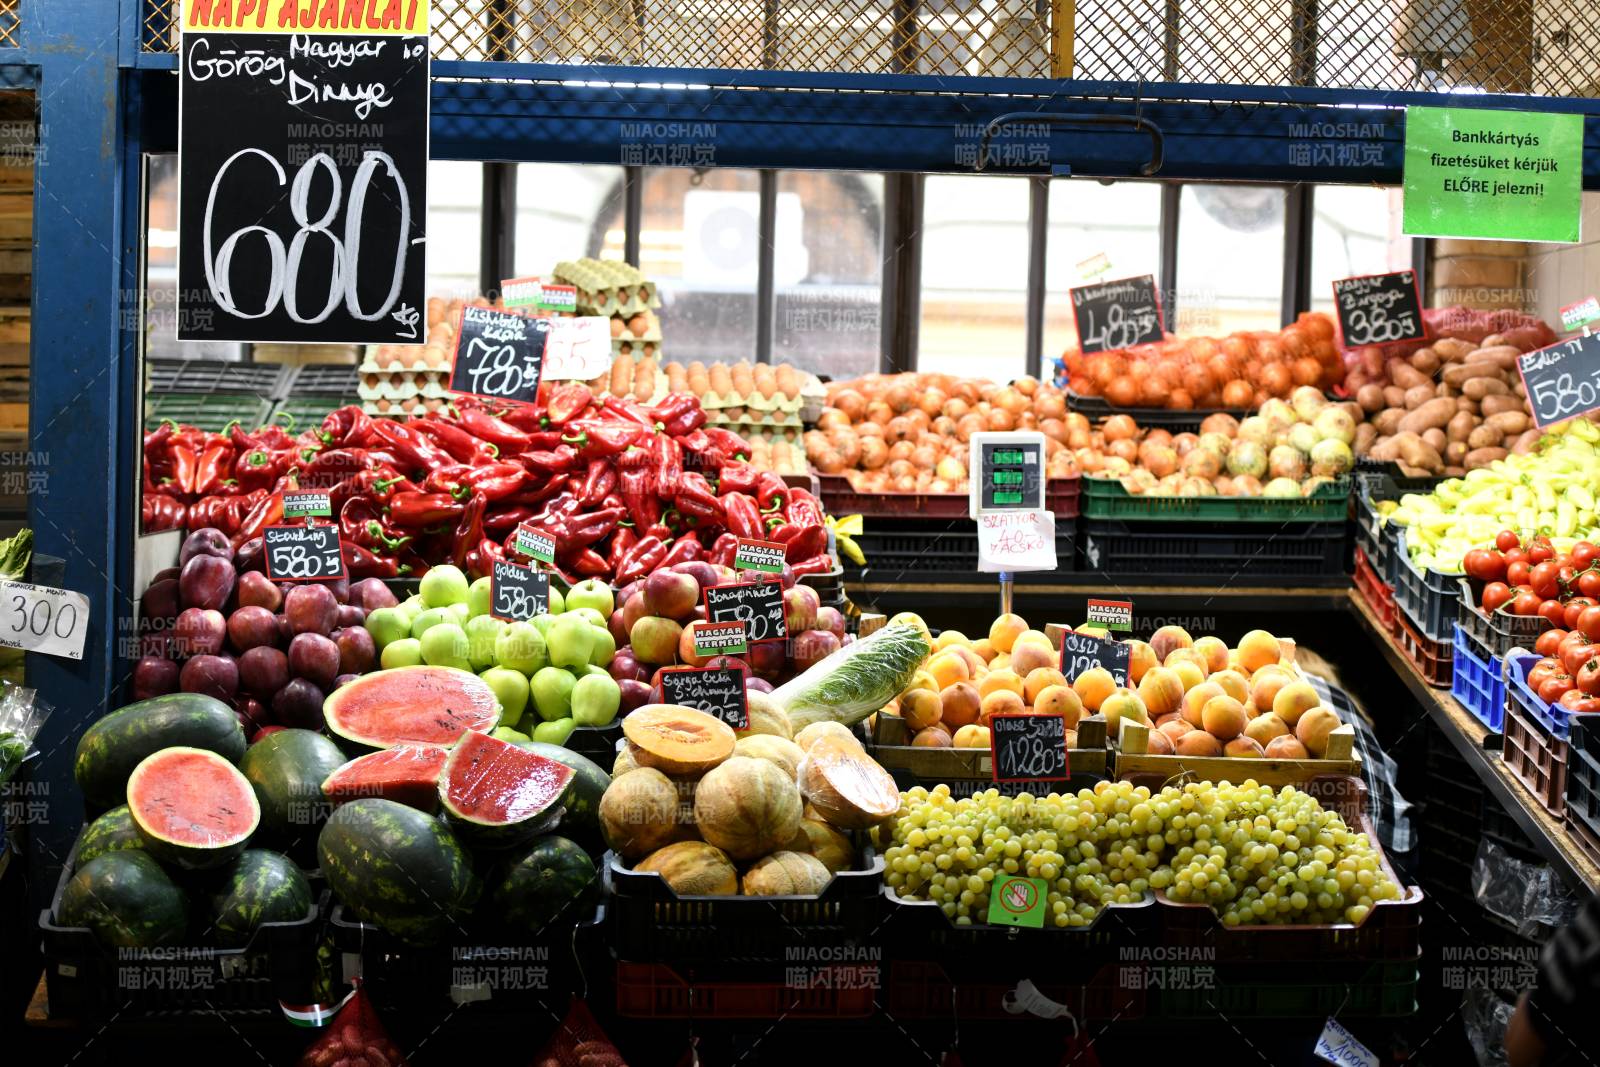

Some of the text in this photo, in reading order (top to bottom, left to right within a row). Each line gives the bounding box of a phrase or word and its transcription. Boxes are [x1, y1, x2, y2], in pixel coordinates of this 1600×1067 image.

[1452, 130, 1539, 148] Bankkártyás
[1430, 153, 1558, 174] fizetésüket kérjük
[1444, 176, 1544, 196] ELŐRE jelezni!
[1533, 373, 1596, 420] 580
[284, 494, 328, 502] MAGYAR
[520, 529, 554, 547] MAGYAR
[740, 544, 784, 557] MAGYAR
[273, 546, 322, 577] 580
[740, 554, 781, 567] TERMÉK
[495, 585, 536, 619] 580
[1090, 605, 1129, 614] MAGYAR
[12, 595, 77, 638] 300
[1091, 615, 1128, 625] TERMÉK
[696, 627, 743, 638] MAGYAR
[698, 637, 742, 649] TERMÉK
[1005, 736, 1055, 776] 1280
